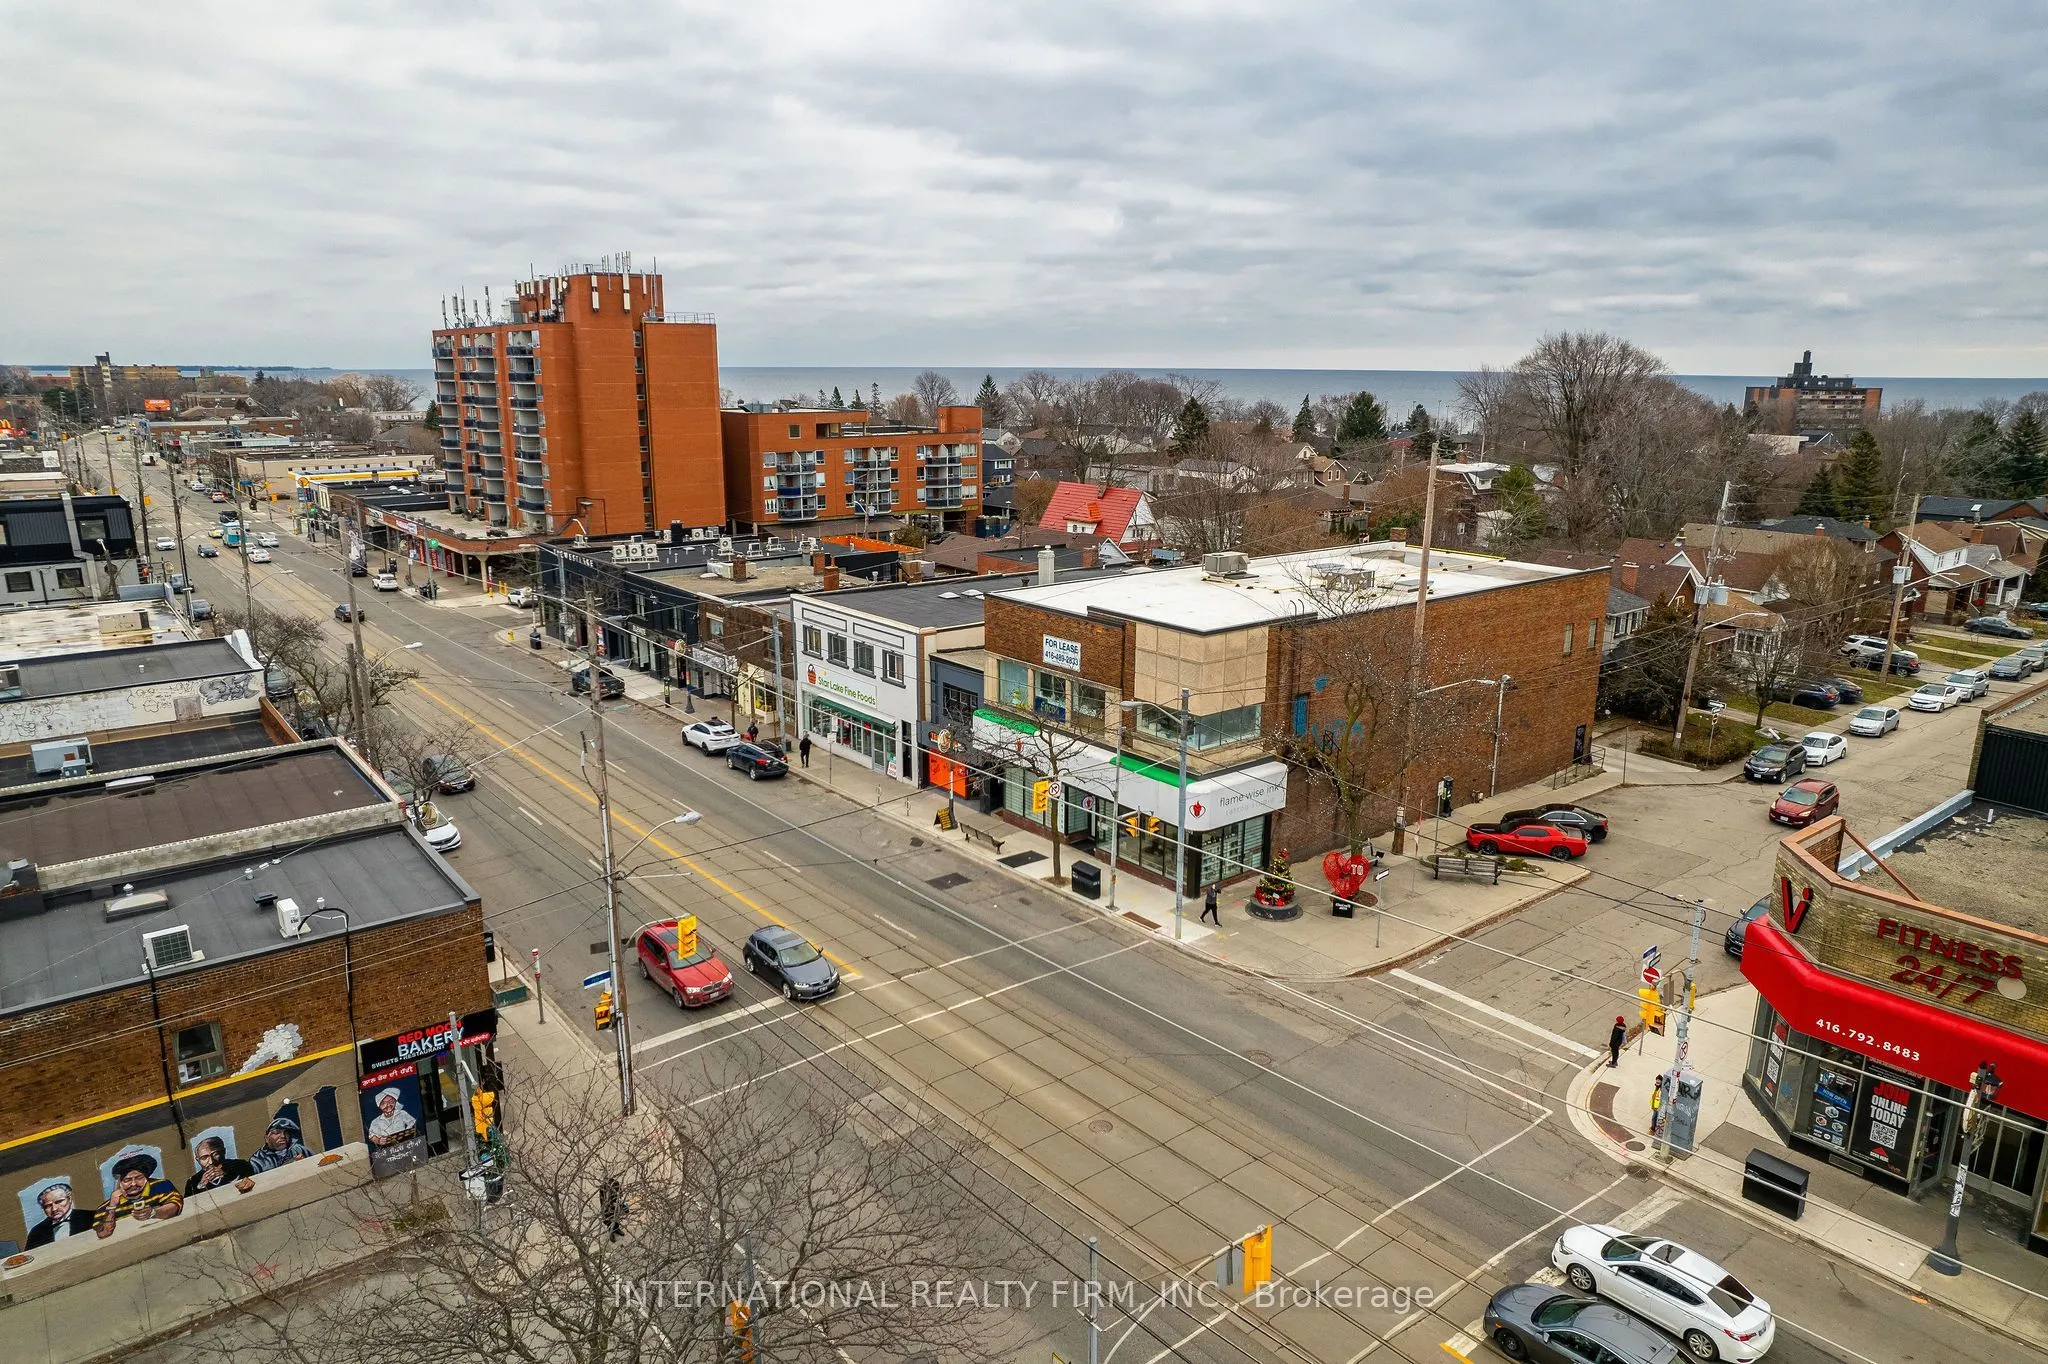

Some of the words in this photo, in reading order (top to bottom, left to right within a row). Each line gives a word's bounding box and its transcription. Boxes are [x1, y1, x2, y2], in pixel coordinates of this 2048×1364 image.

[1045, 638, 1058, 649] FOR
[1058, 642, 1079, 654] LEASE
[818, 676, 830, 688] Star
[830, 682, 844, 694] Lake
[844, 686, 857, 698] Fine
[857, 691, 876, 706] Foods
[1351, 863, 1364, 876] TO
[1877, 917, 2024, 980] FITNESS
[1890, 954, 1995, 1004] 24/7
[398, 1030, 423, 1045] RED
[398, 1027, 465, 1057] BAKERY
[1815, 1018, 1921, 1062] 416.792.8483
[371, 1057, 399, 1070] SWEETS
[403, 1044, 446, 1061] RESTAURANT
[1873, 1080, 1910, 1105] JOIN
[1870, 1105, 1905, 1129] TODAY
[1871, 1094, 1908, 1117] ONLINE
